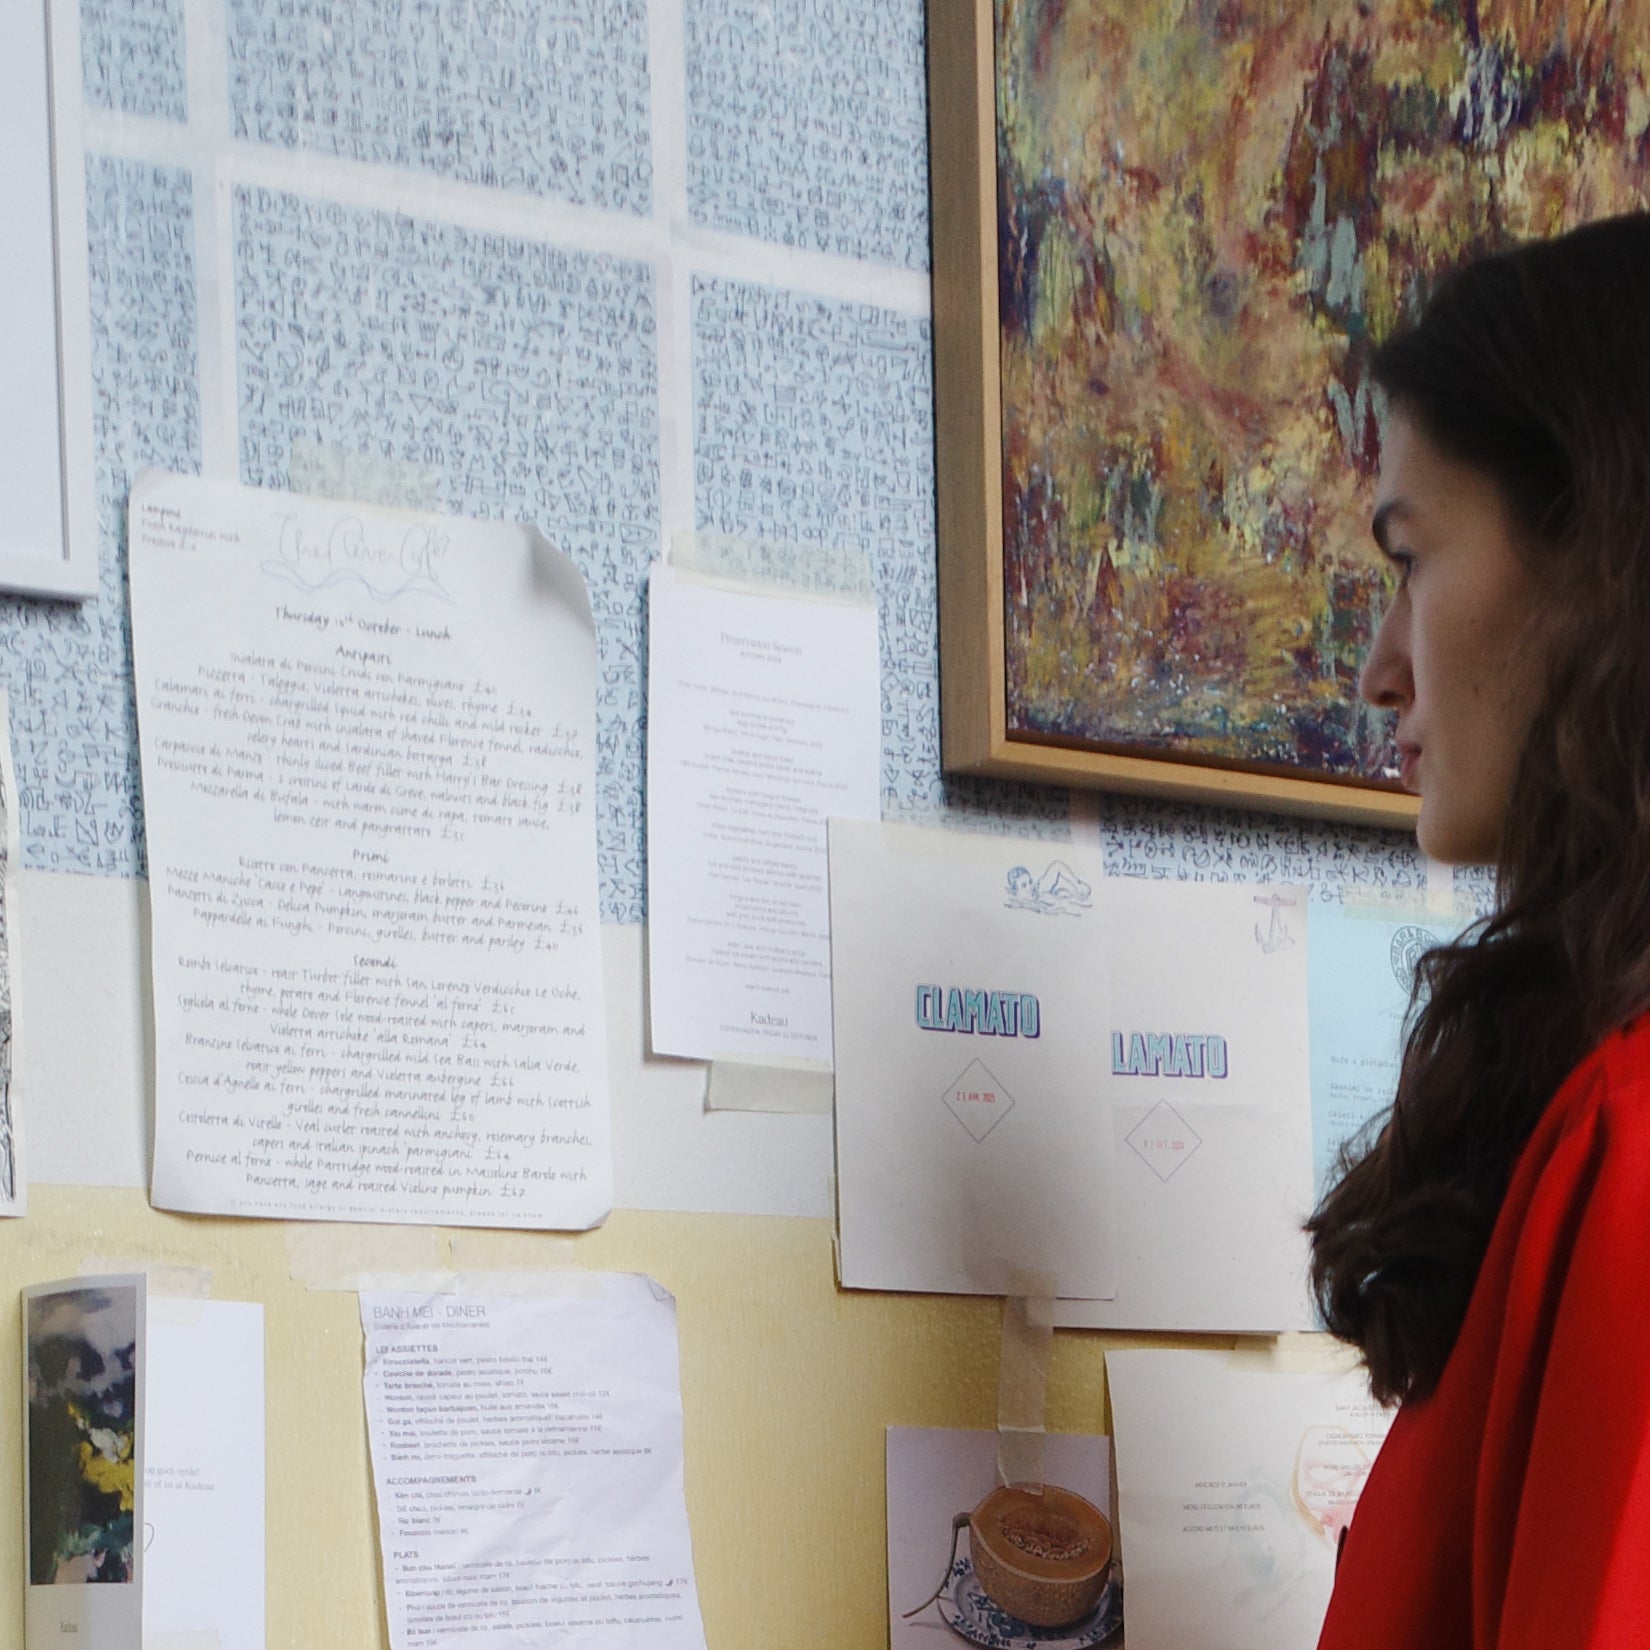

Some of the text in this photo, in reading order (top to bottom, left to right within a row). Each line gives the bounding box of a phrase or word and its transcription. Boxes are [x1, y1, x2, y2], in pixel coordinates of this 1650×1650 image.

[273, 602, 330, 631] Thursday
[356, 616, 402, 636] October
[414, 624, 451, 641] Lunch
[334, 643, 392, 666] Antipasti
[245, 726, 277, 749] celery
[280, 729, 315, 751] hearts
[317, 738, 341, 753] and
[344, 741, 403, 759] Sardinian
[224, 746, 263, 765] Manzo
[275, 748, 311, 771] thinly
[346, 759, 373, 777] Beef
[405, 764, 432, 781] with
[479, 772, 502, 789] Bar
[504, 776, 549, 797] Dressing
[351, 847, 390, 865] Primi
[165, 865, 199, 883] Mezze
[412, 885, 443, 905] black
[443, 894, 477, 912] pepper
[478, 895, 502, 910] and
[192, 905, 252, 928] Pappardelle
[271, 914, 313, 936] Funghi
[420, 924, 458, 945] butter
[460, 931, 485, 946] and
[486, 932, 526, 953] parsley
[352, 953, 398, 970] Secondi
[238, 977, 276, 999] thyme,
[278, 986, 314, 1004] potato
[316, 988, 341, 1003] and
[343, 987, 391, 1008] Florence
[392, 991, 429, 1009] fennel
[231, 996, 260, 1015] forno
[270, 998, 298, 1020] whole
[300, 1005, 331, 1022] Dover
[334, 1005, 354, 1023] Sole
[356, 1010, 427, 1028] wood-roasted
[429, 1011, 457, 1030] with
[459, 1019, 498, 1035] capers,
[500, 1021, 559, 1039] marjoram
[561, 1022, 586, 1037] and
[916, 984, 1040, 1038] CLAMATO
[269, 1020, 313, 1039] Violetta
[315, 1023, 369, 1043] artichoke
[298, 1041, 328, 1059] ferri
[339, 1043, 402, 1066] chargrilled
[403, 1048, 430, 1065] wild
[432, 1052, 452, 1067] Sea
[455, 1052, 480, 1068] Bass
[482, 1052, 511, 1070] with
[512, 1054, 541, 1071] Salsa
[544, 1058, 580, 1074] Verde,
[1111, 1030, 1228, 1079] LAMATO
[285, 1097, 323, 1118] girolles
[326, 1101, 351, 1116] and
[351, 1100, 381, 1118] fresh
[244, 1171, 300, 1189] Pancetta,
[303, 1177, 328, 1195] sage
[330, 1176, 355, 1191] and
[356, 1179, 398, 1193] roasted
[440, 1179, 493, 1201] pumpkin
[373, 1306, 409, 1319] BANH
[446, 1304, 487, 1318] DINER
[391, 1344, 438, 1354] ASSIETTES
[386, 1475, 477, 1486] ACCOMPAGNEMENTS
[393, 1551, 420, 1560] PLATS
